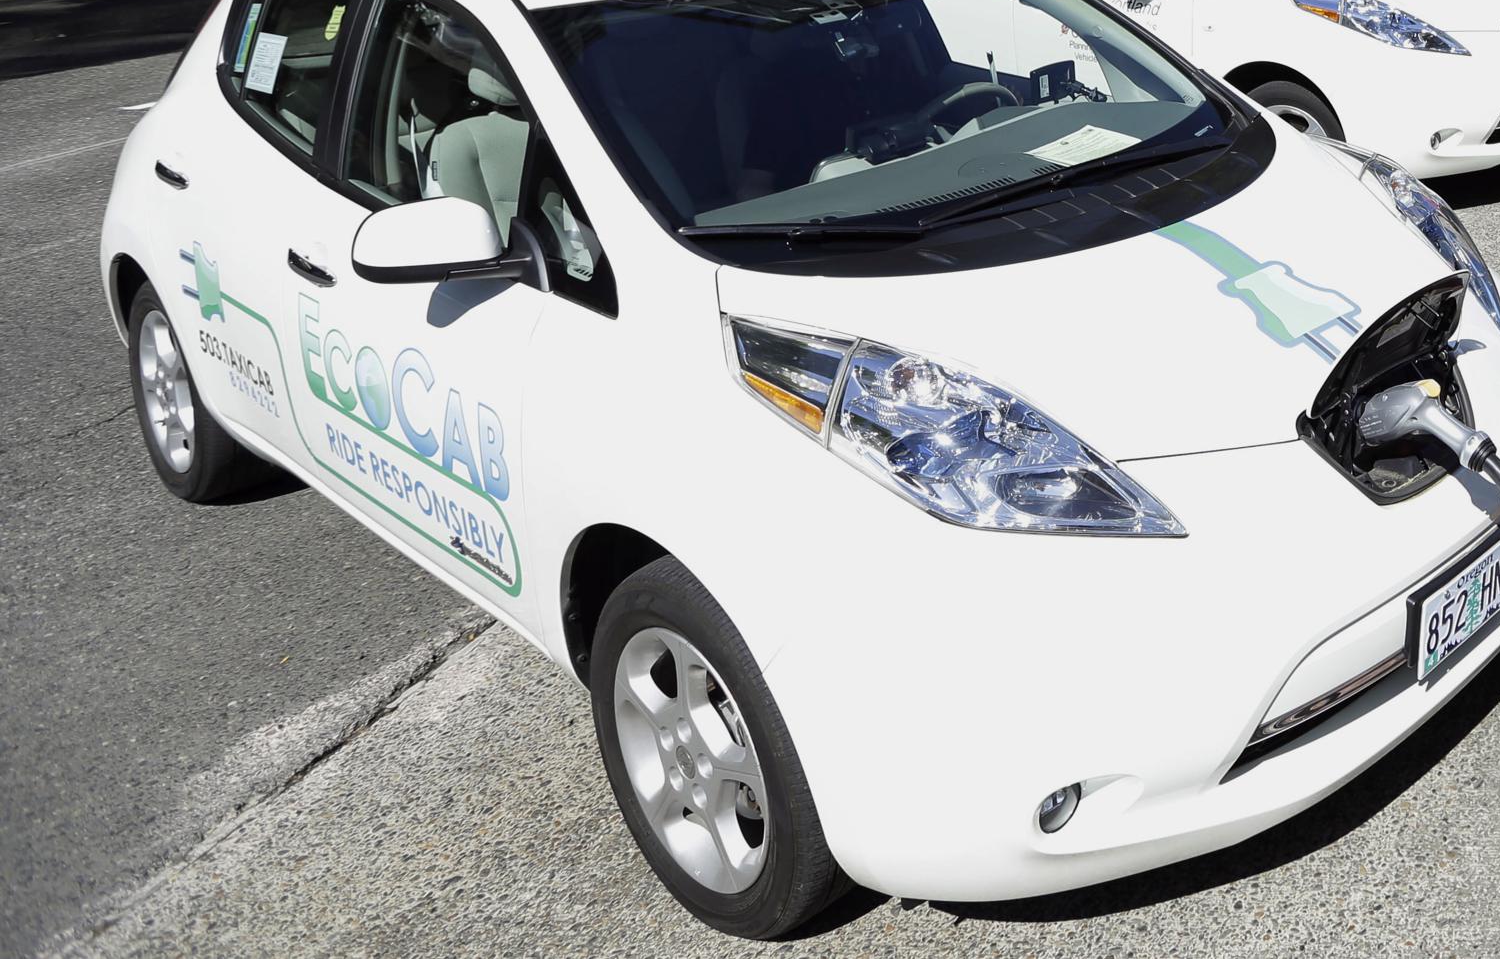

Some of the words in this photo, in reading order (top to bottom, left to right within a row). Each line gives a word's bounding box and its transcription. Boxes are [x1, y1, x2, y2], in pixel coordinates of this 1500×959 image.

[199, 330, 274, 396] 503.TAXICAB
[325, 422, 367, 474] RIDE
[369, 451, 504, 563] RESPONSIBLY
[1457, 554, 1494, 589] Oregon
[1426, 589, 1468, 655] 852
